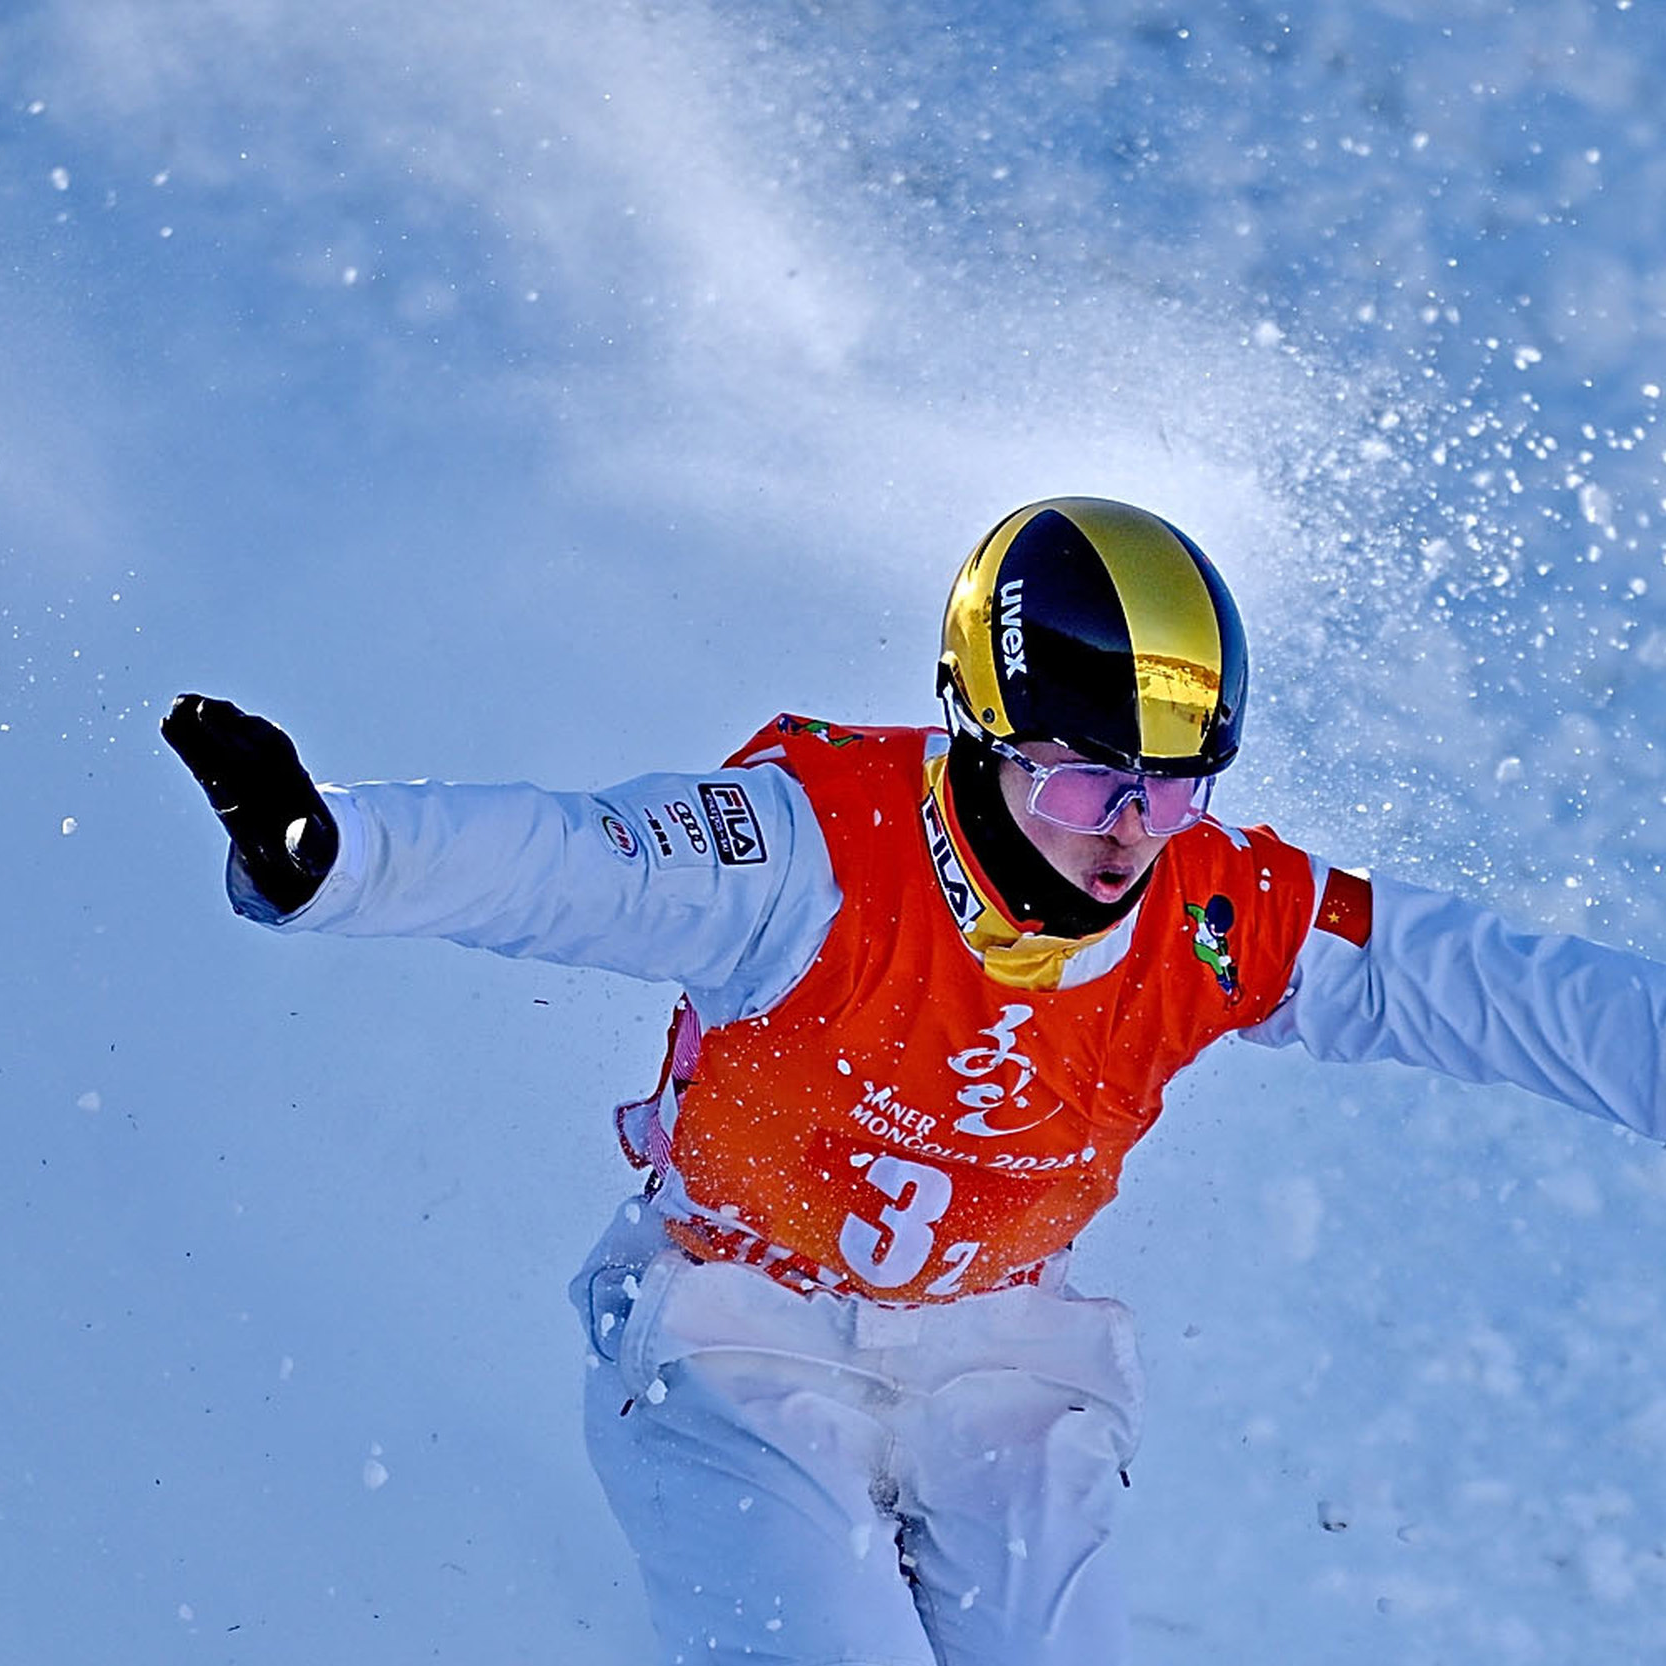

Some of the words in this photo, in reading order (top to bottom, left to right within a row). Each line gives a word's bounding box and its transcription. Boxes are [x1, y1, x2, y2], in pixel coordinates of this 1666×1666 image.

[999, 579, 1028, 680] uvex
[714, 790, 757, 858] FILA
[925, 796, 970, 919] FILA
[862, 1088, 938, 1136] INNER
[838, 1155, 953, 1289] 3
[924, 1241, 981, 1296] 2
